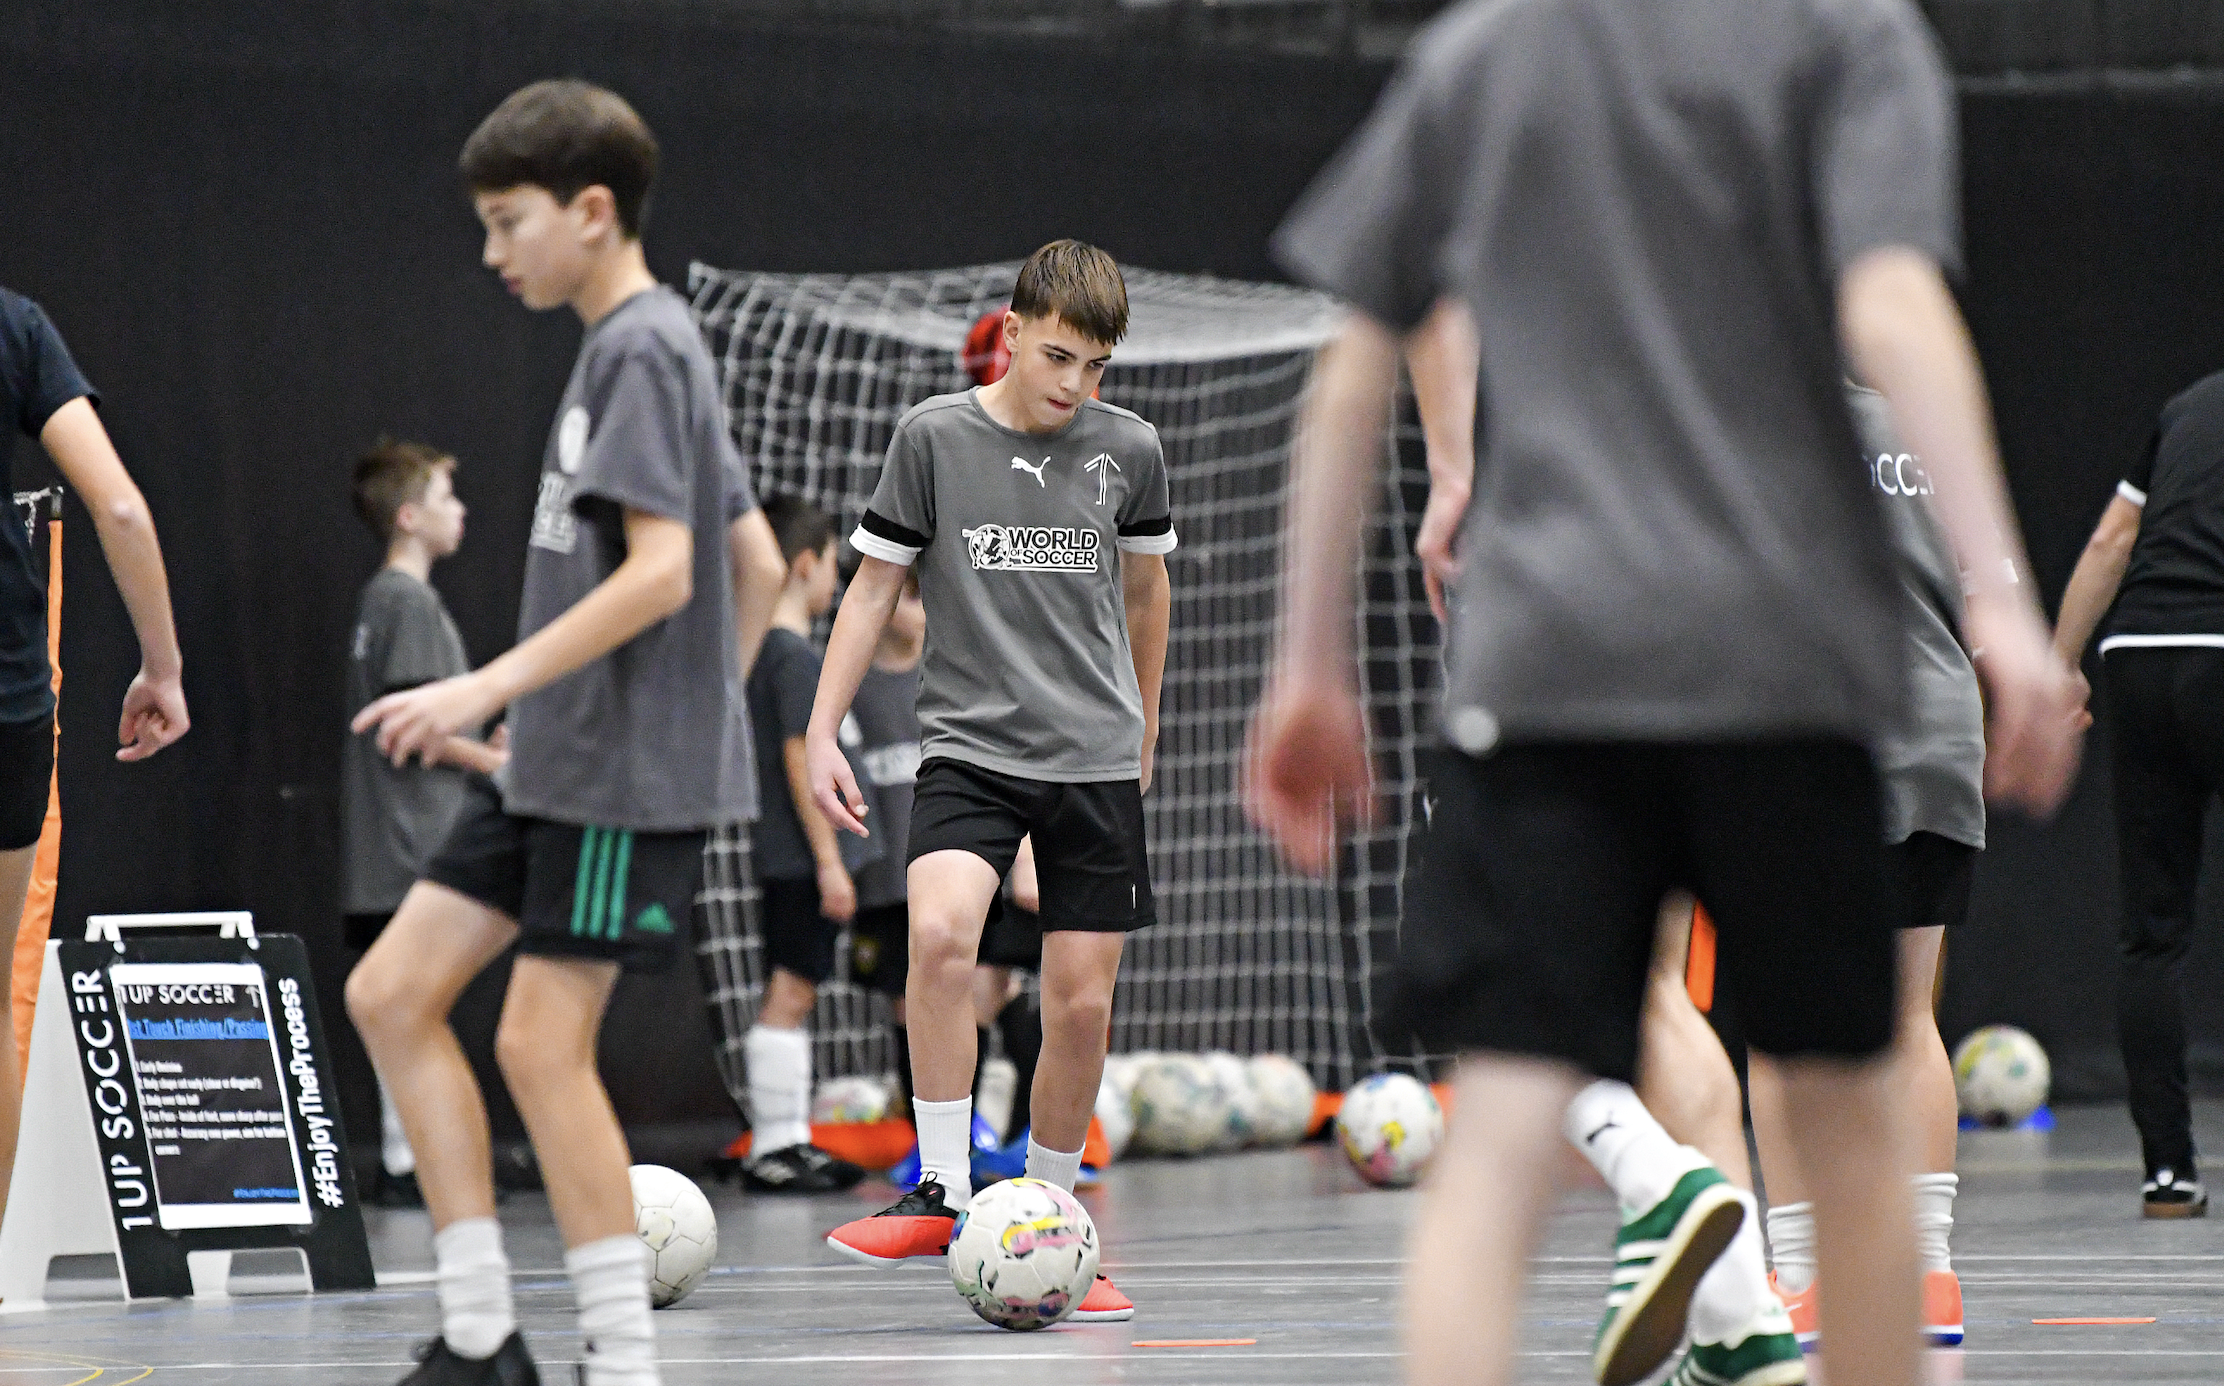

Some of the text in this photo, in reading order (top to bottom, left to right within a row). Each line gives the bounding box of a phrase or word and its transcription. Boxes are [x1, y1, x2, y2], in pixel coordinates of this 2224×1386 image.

[1008, 529, 1098, 550] WORLD
[1010, 549, 1023, 557] OF
[1023, 549, 1096, 565] SOCCER
[158, 985, 236, 1004] SOCCER
[72, 968, 135, 1140] SOCCER
[278, 977, 344, 1209] #EnjoyTheProcess
